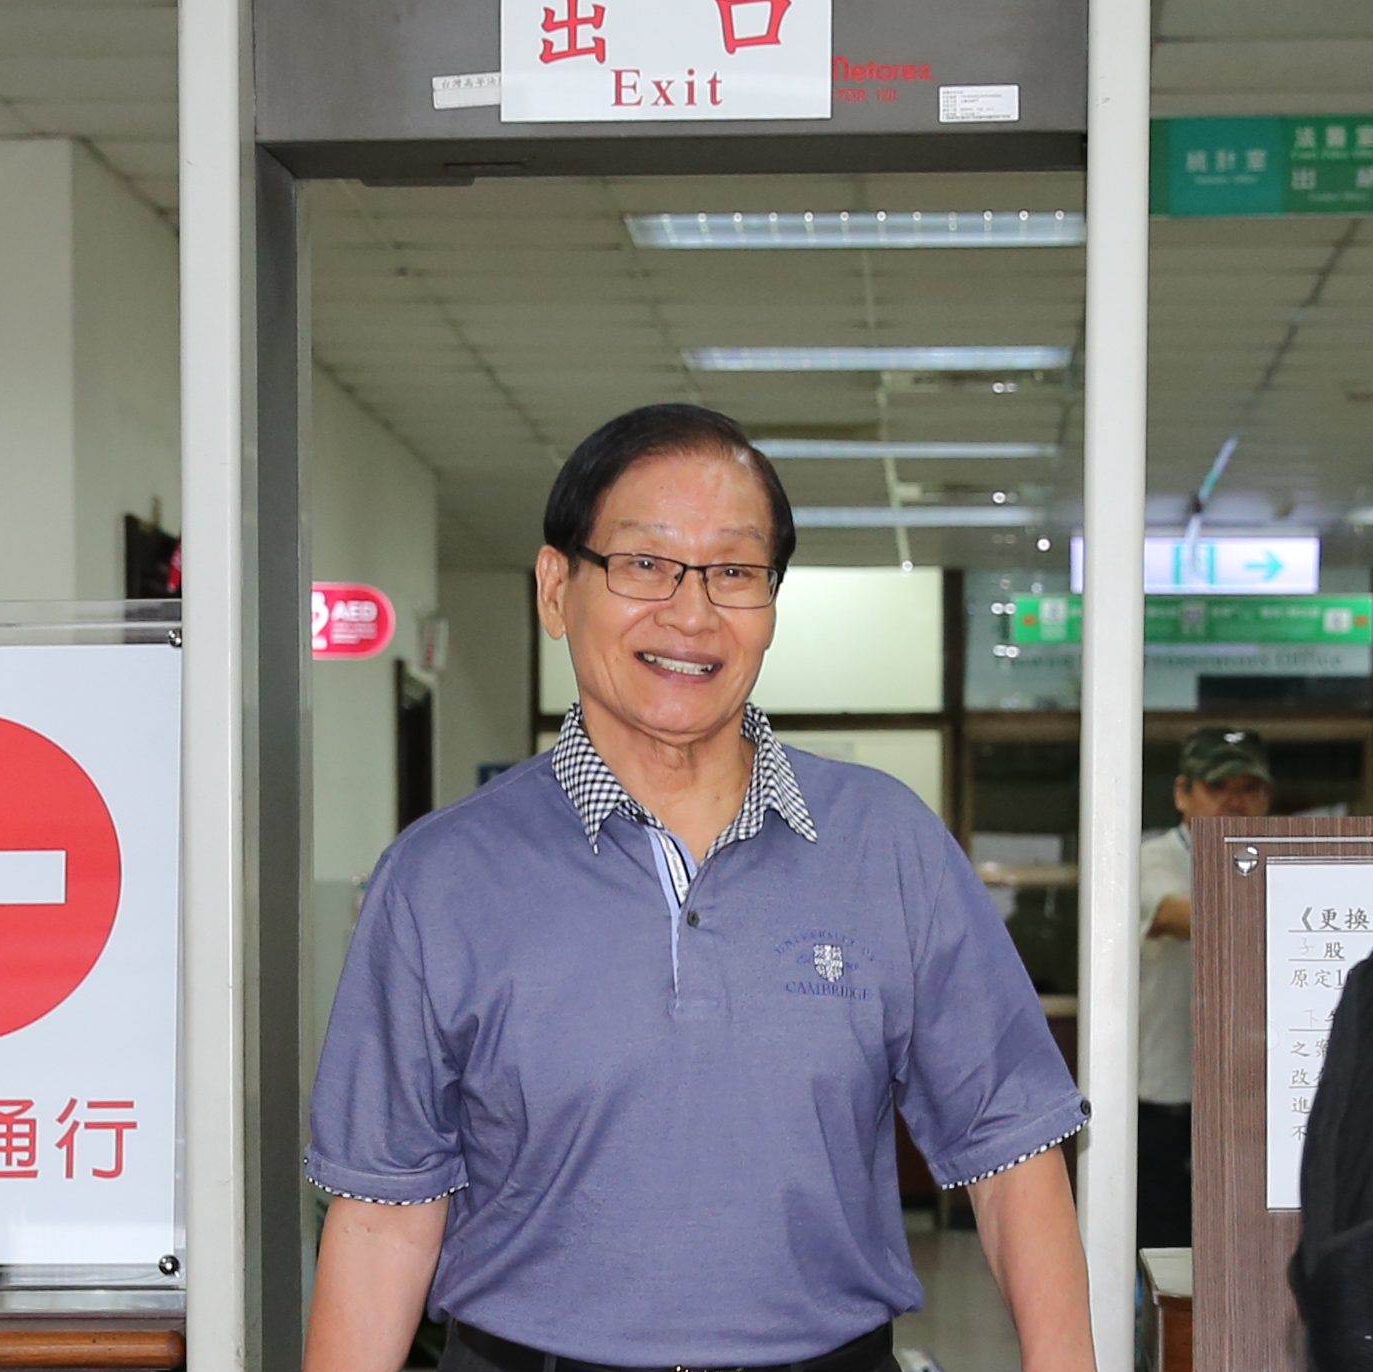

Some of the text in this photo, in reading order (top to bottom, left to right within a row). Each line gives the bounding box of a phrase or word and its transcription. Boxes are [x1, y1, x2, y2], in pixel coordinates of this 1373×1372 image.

[540, 0, 792, 64] 出口
[442, 76, 501, 89] 台灣高等法
[611, 69, 723, 106] Exit
[331, 600, 378, 622] AED
[785, 981, 869, 999] CAMBRIDGE
